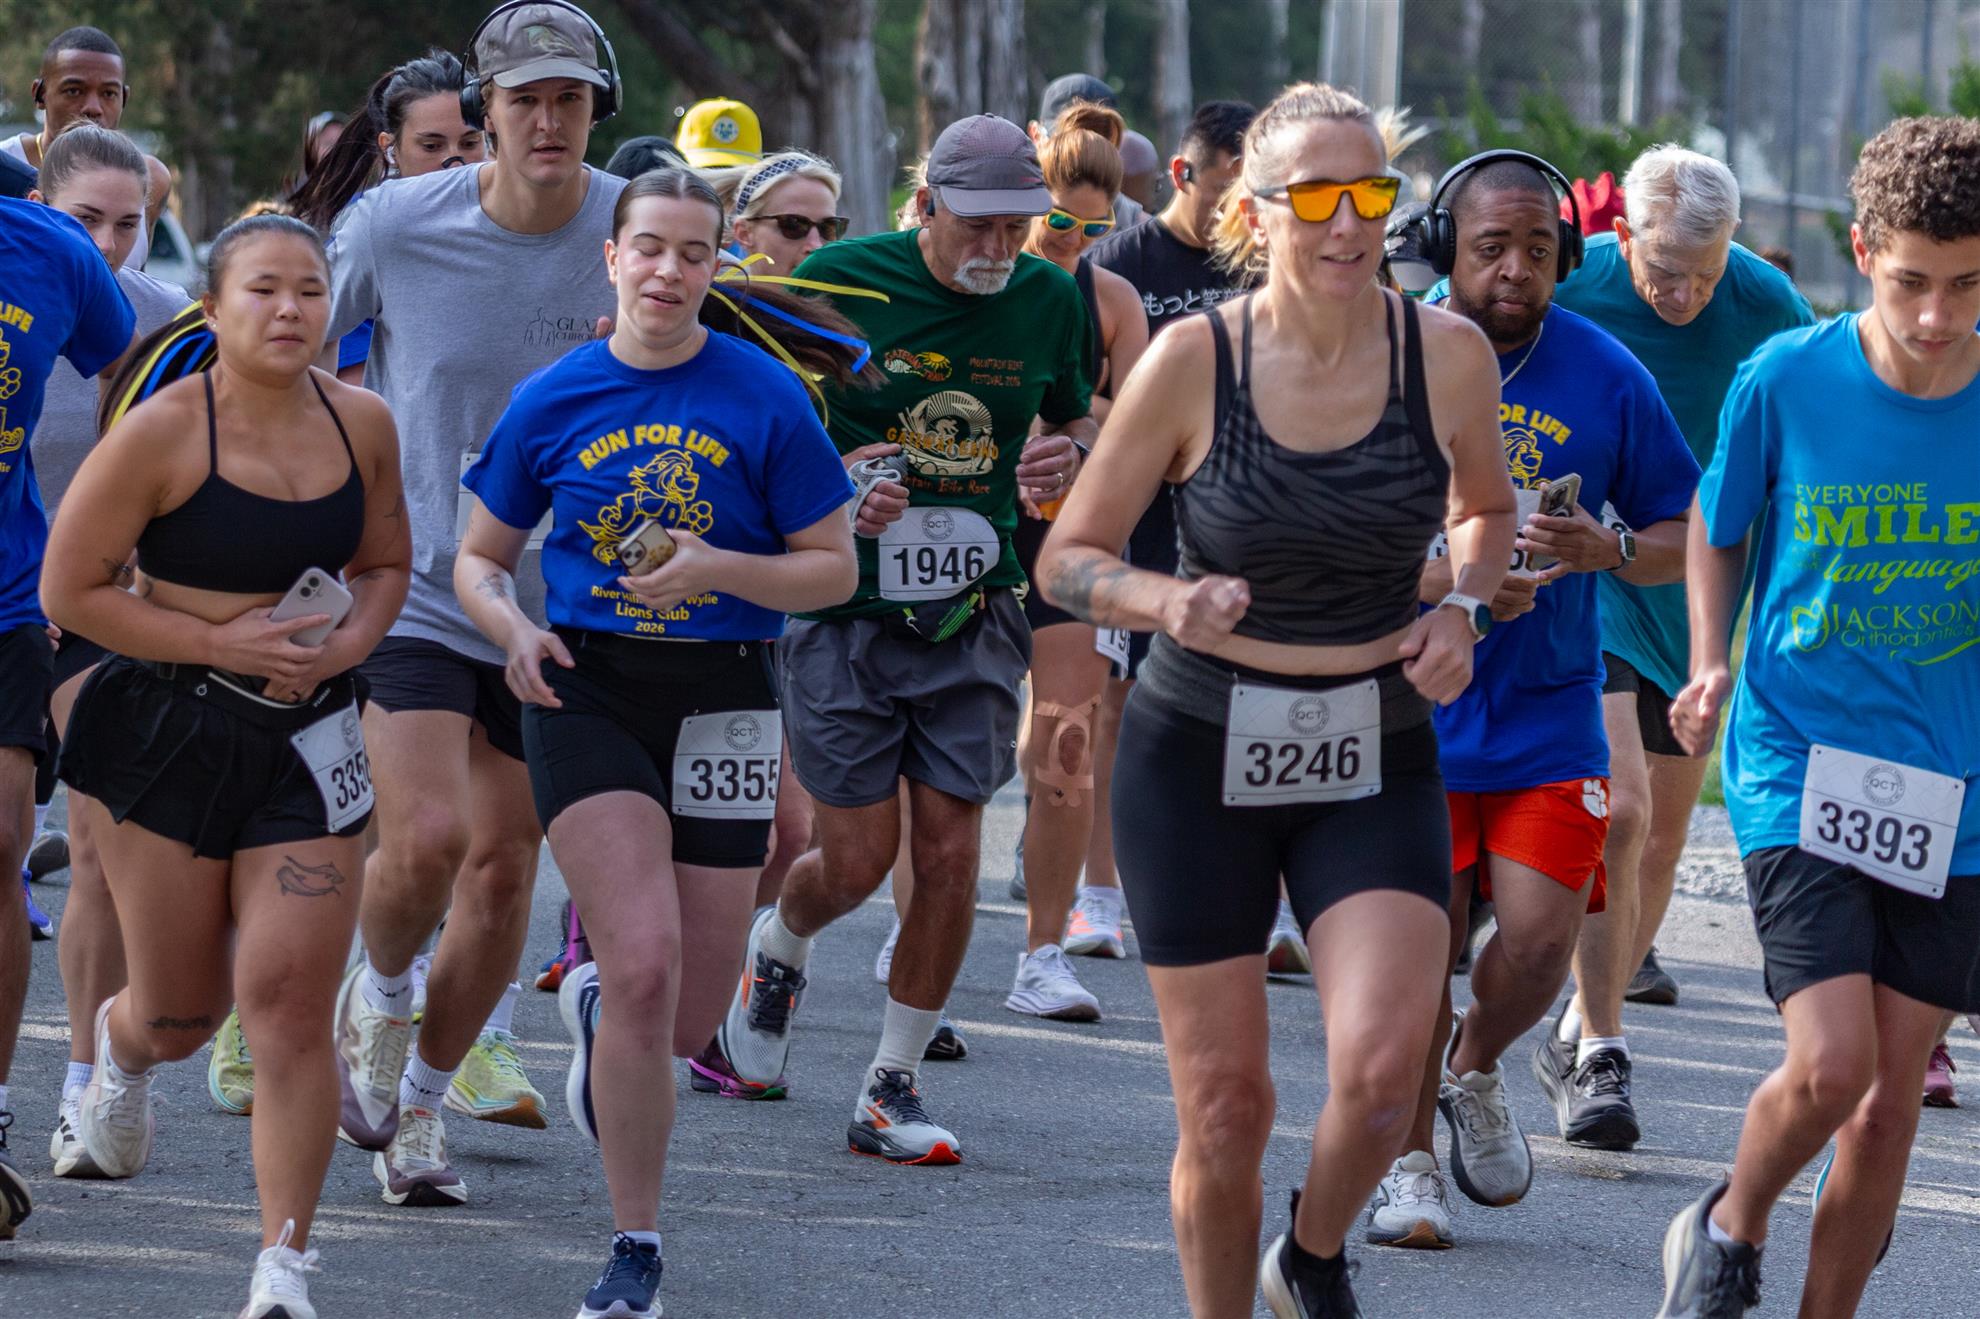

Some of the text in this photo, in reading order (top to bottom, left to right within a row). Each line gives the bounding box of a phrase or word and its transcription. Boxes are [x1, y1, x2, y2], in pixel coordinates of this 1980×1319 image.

[1529, 409, 1572, 446] LIFE
[577, 423, 730, 471] RUN FOR LIFE
[1796, 483, 1928, 504] EVERYONE
[926, 519, 949, 529] QCT
[893, 546, 985, 586] 1946
[591, 585, 621, 600] River
[615, 602, 653, 620] Lions
[1831, 600, 1980, 636] JACKSON
[635, 621, 666, 634] 2026
[1295, 711, 1322, 720] QCT
[731, 728, 754, 737] QCT
[1245, 737, 1360, 787] 3246
[1869, 777, 1899, 792] QCT
[1817, 801, 1932, 871] 3393
